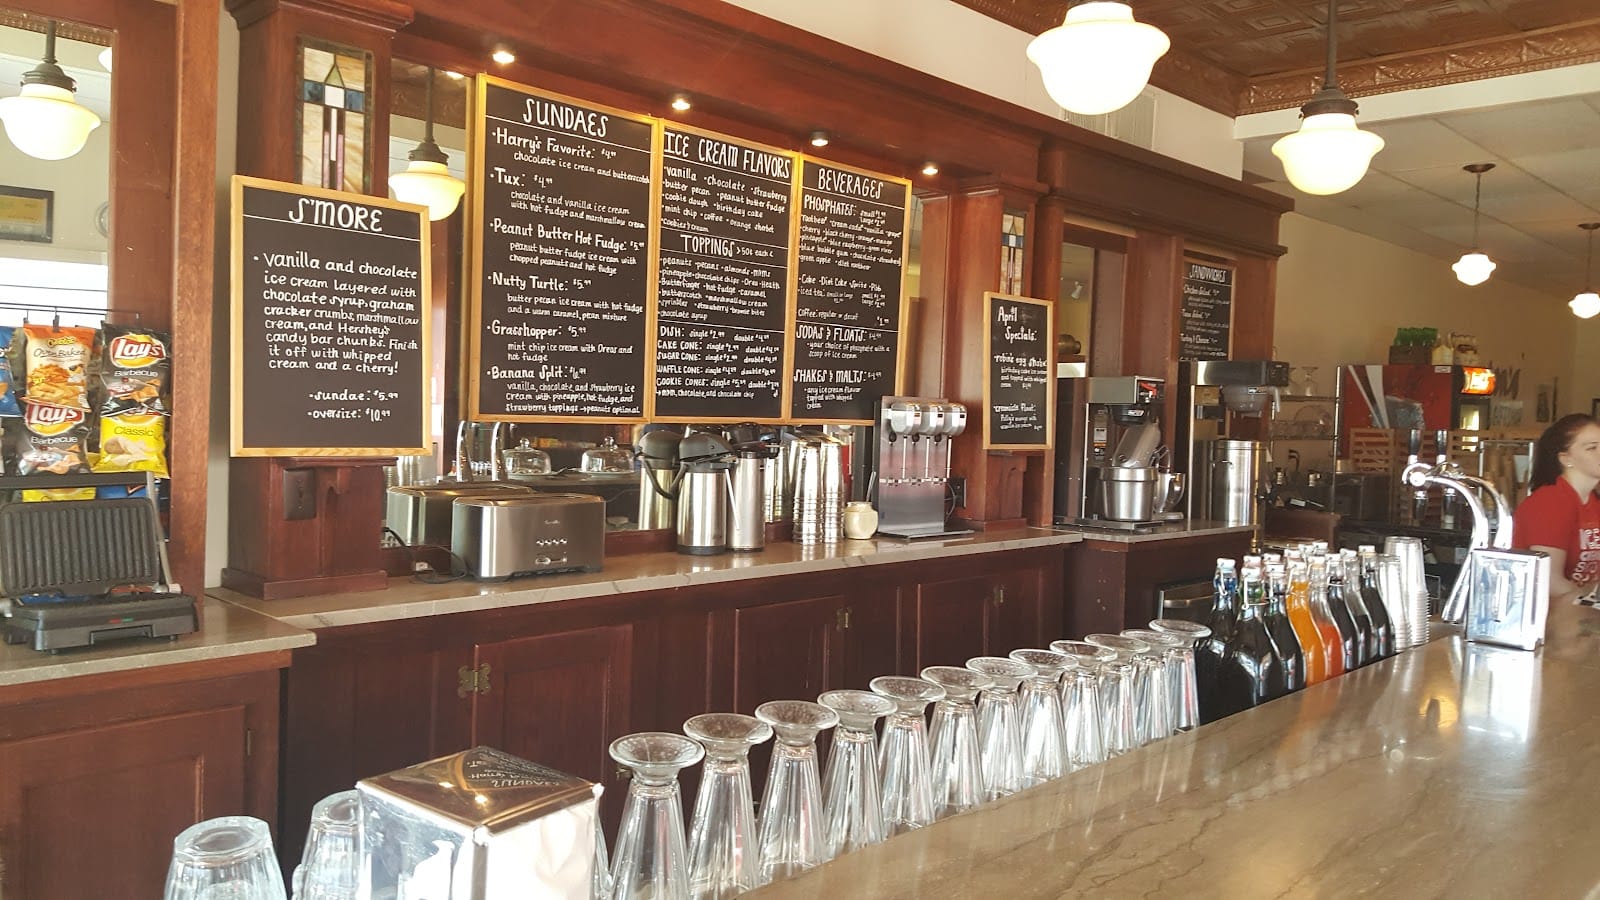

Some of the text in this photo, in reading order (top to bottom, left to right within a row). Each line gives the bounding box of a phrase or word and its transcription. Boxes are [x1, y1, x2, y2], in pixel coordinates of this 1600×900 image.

[523, 99, 608, 137] SUNDAES
[664, 131, 790, 179] ICE CREAM FLAVORS
[818, 168, 883, 199] BEVERAGES
[804, 195, 856, 216] PHOSPHATES:
[289, 198, 383, 232] S'MORE
[680, 234, 734, 257] TOPPINGS
[264, 251, 417, 279] vanilla and chocolate
[264, 271, 416, 297] ice cream layered with
[263, 289, 327, 304] chocolate
[369, 301, 414, 312] graham
[264, 306, 312, 317] cracker
[998, 306, 1017, 326] April
[309, 321, 333, 331] and
[338, 323, 390, 338] Hershey's
[660, 326, 684, 337] DISH:
[796, 325, 824, 338] SODAS
[833, 330, 867, 342] FLOATS:
[266, 333, 418, 350] candy bar chunks. Finish
[658, 340, 702, 350] CAKE CONE:
[269, 345, 392, 363] it off with whipped
[657, 352, 700, 360] SUGAR CONE:
[269, 360, 310, 369] cream
[316, 361, 337, 370] and
[356, 361, 399, 375] cherry!
[657, 365, 703, 374] WAFFLE CONE:
[794, 369, 827, 382] SHAKES
[836, 371, 866, 382] MALTS:
[657, 378, 681, 386] COOKIE
